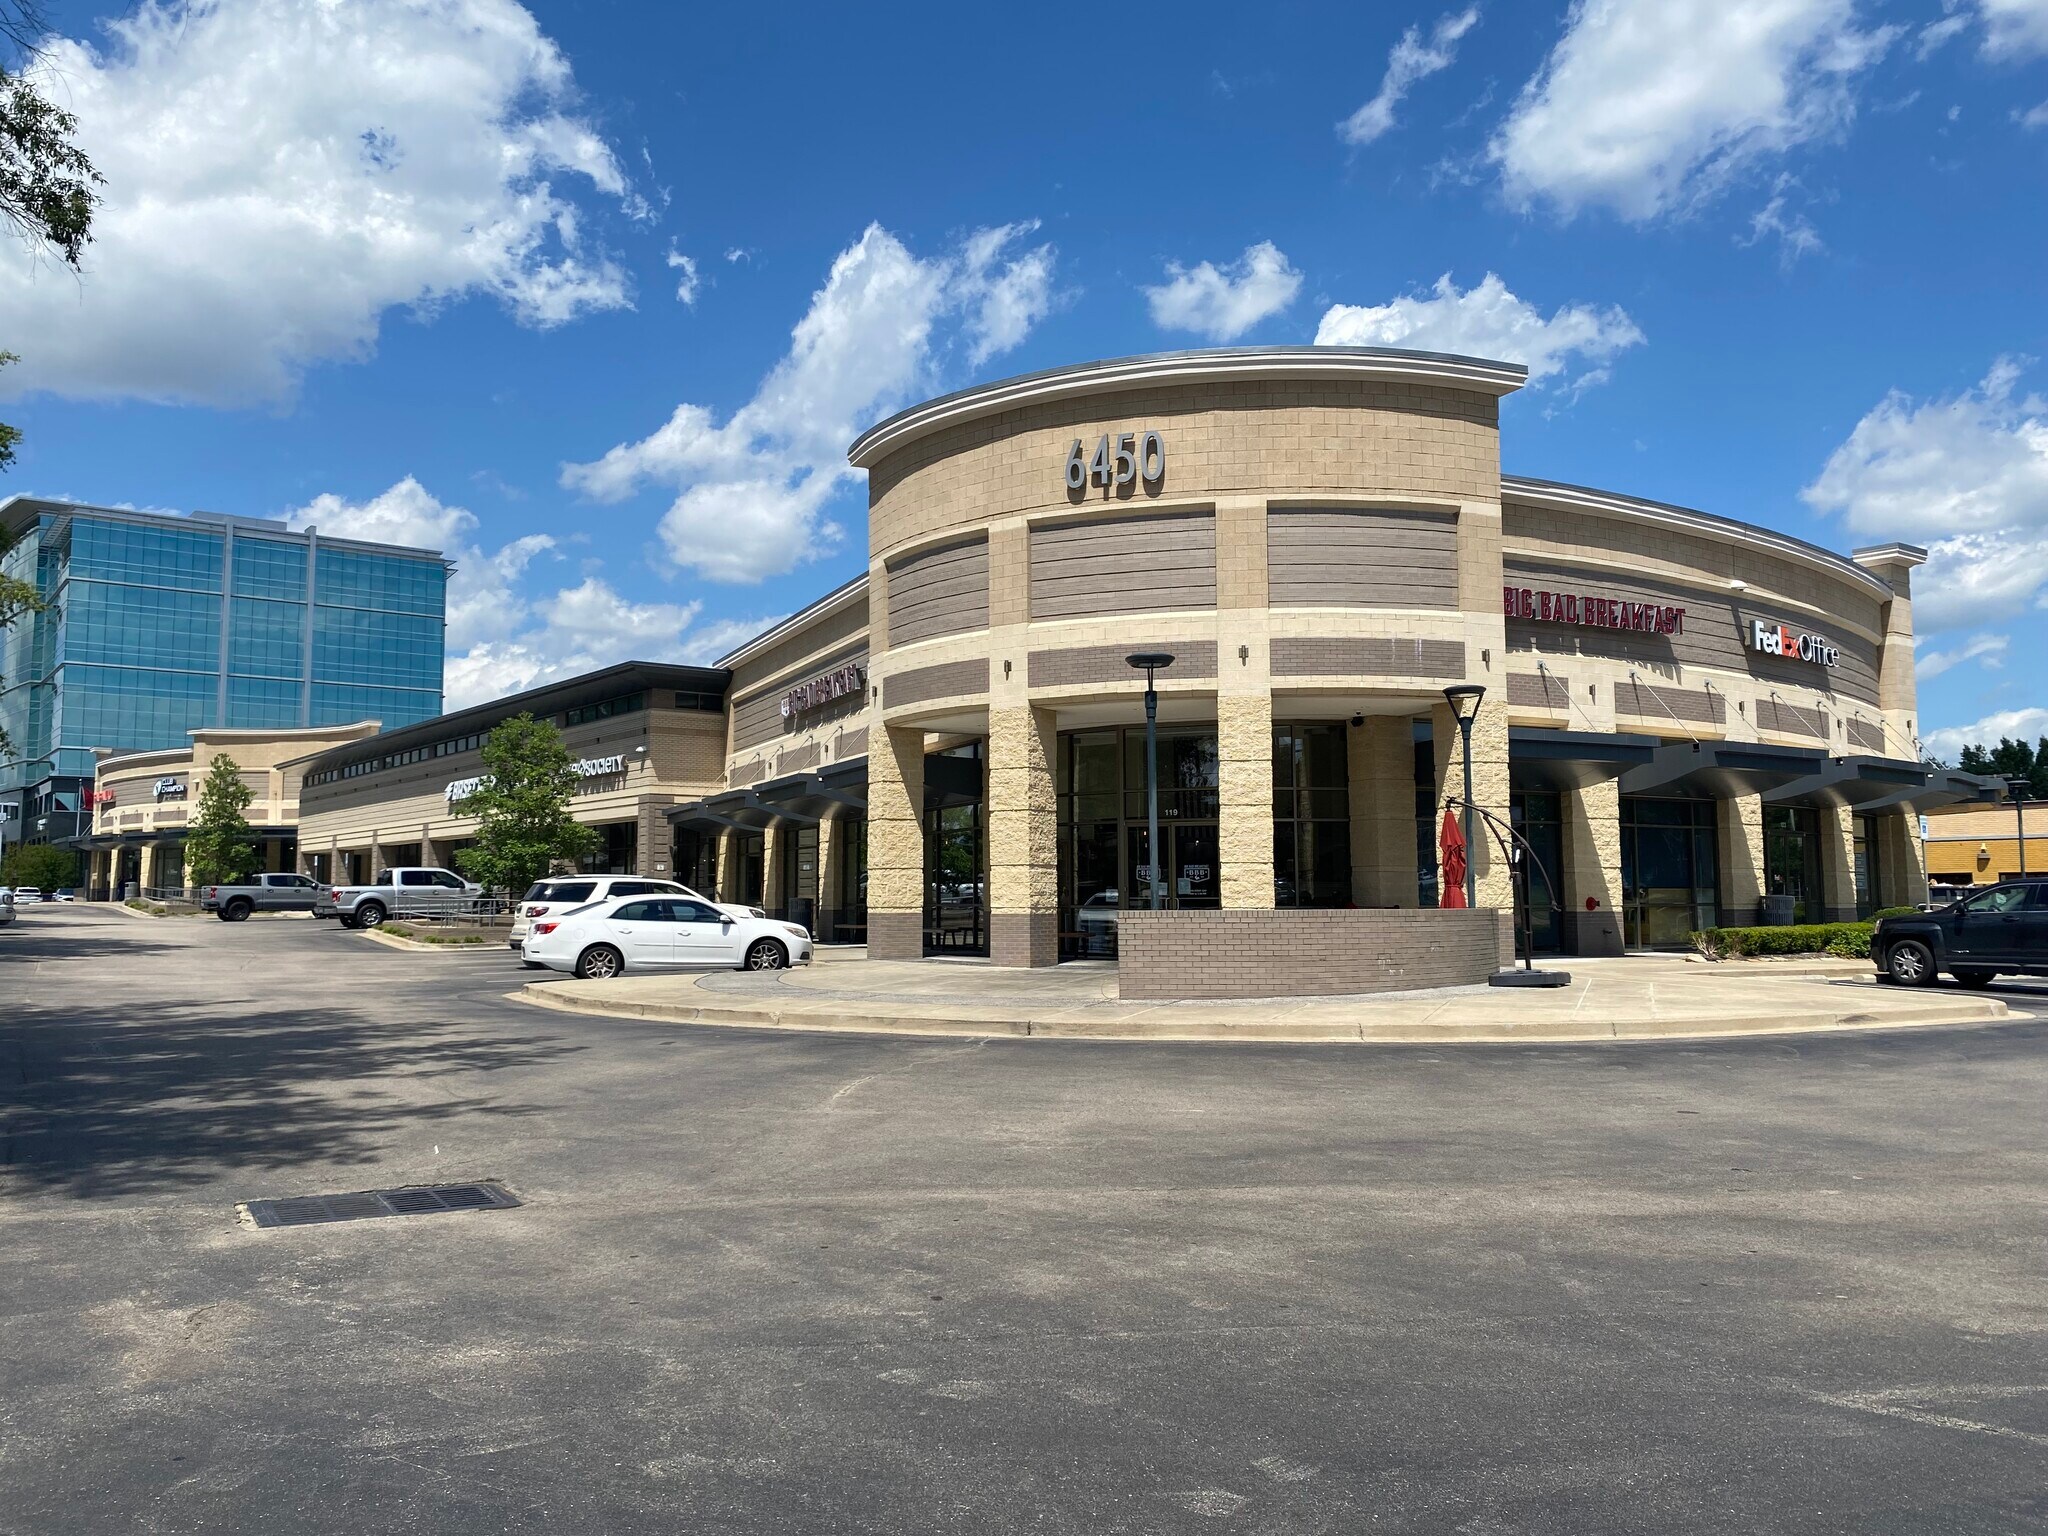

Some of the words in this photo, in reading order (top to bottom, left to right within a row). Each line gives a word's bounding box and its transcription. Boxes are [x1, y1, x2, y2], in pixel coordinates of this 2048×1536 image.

[1065, 430, 1164, 489] 6450
[1503, 586, 1534, 619] BIG
[1537, 591, 1578, 624] BAD
[1581, 596, 1687, 636] BREAKFAST
[1754, 620, 1801, 660] FedEx
[1800, 633, 1840, 668] Office
[161, 777, 174, 786] CLUB
[161, 785, 184, 793] CHAMPION
[1164, 808, 1178, 816] 119
